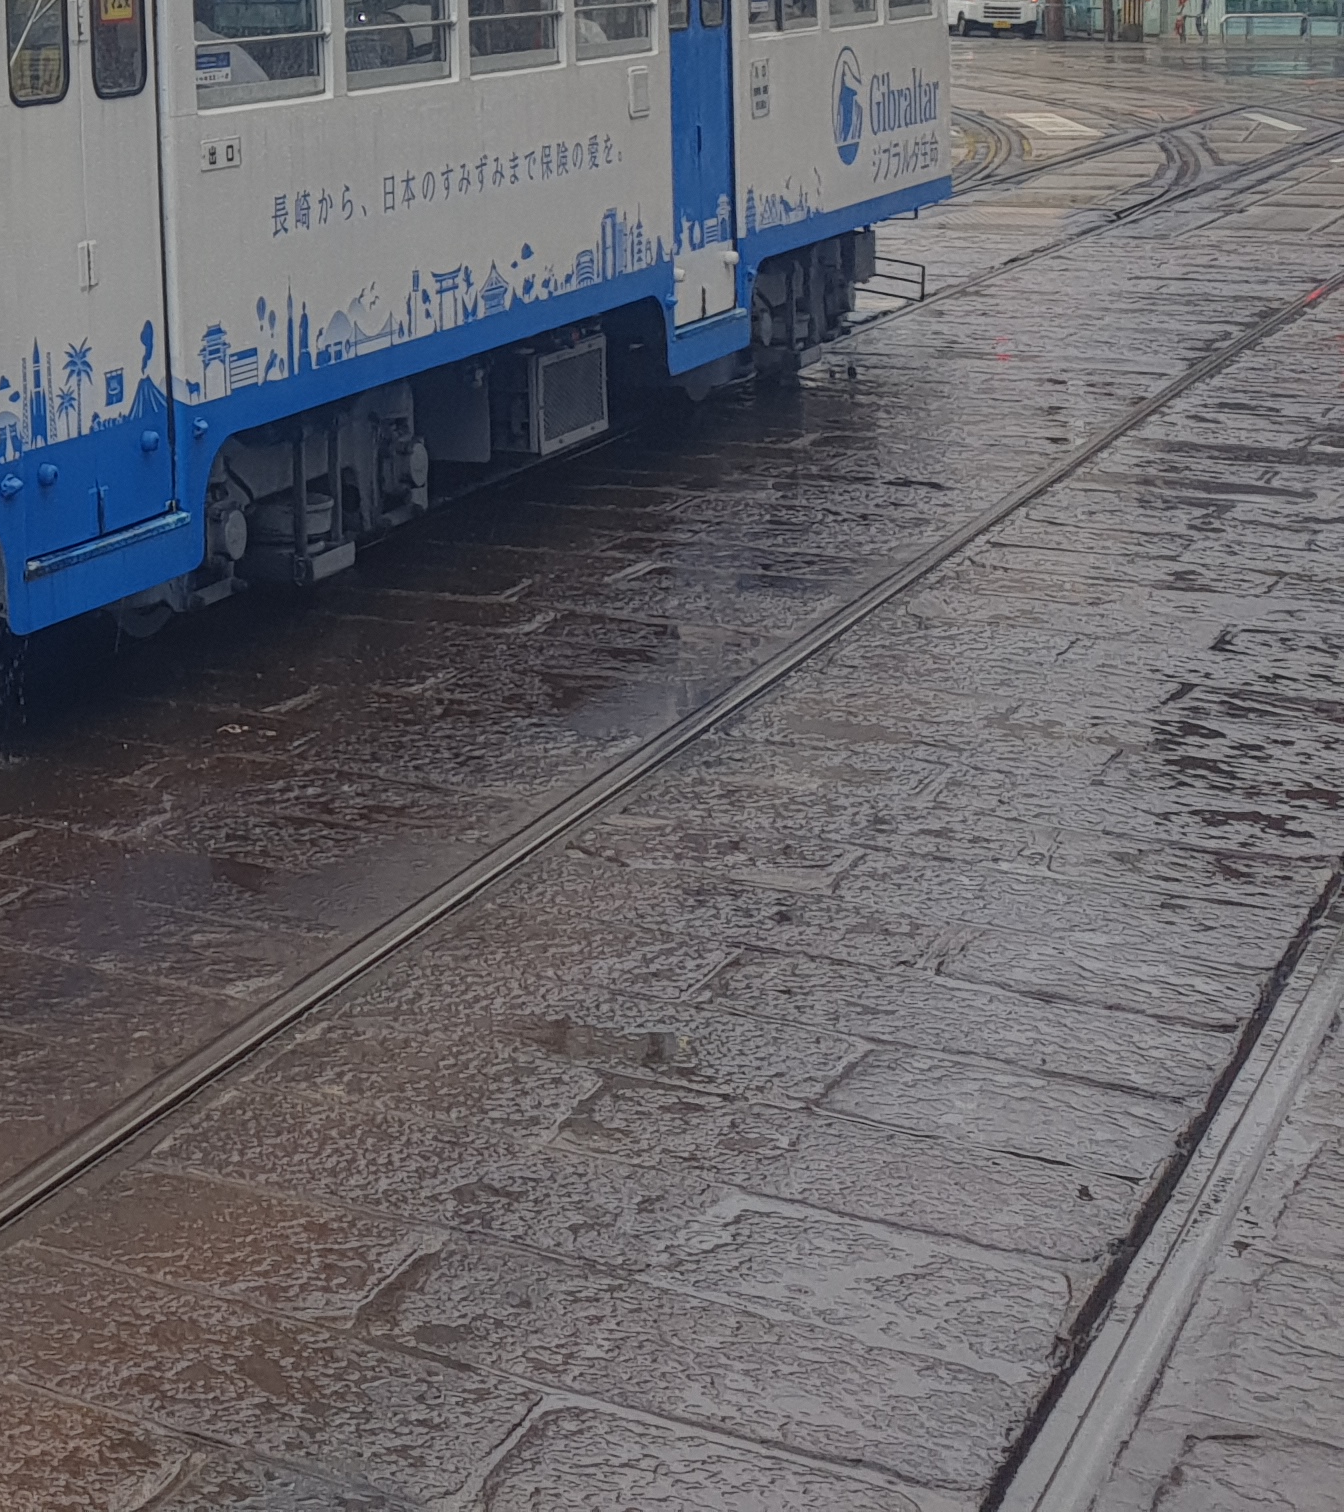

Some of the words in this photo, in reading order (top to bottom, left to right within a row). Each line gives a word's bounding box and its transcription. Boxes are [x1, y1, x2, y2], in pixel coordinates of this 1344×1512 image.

[870, 67, 939, 136] Gibraltar
[208, 144, 234, 165] 出口
[873, 130, 939, 183] ジブラルタ生命
[272, 134, 624, 238] 長崎から、日本のすみずみまで保険の愛を。
